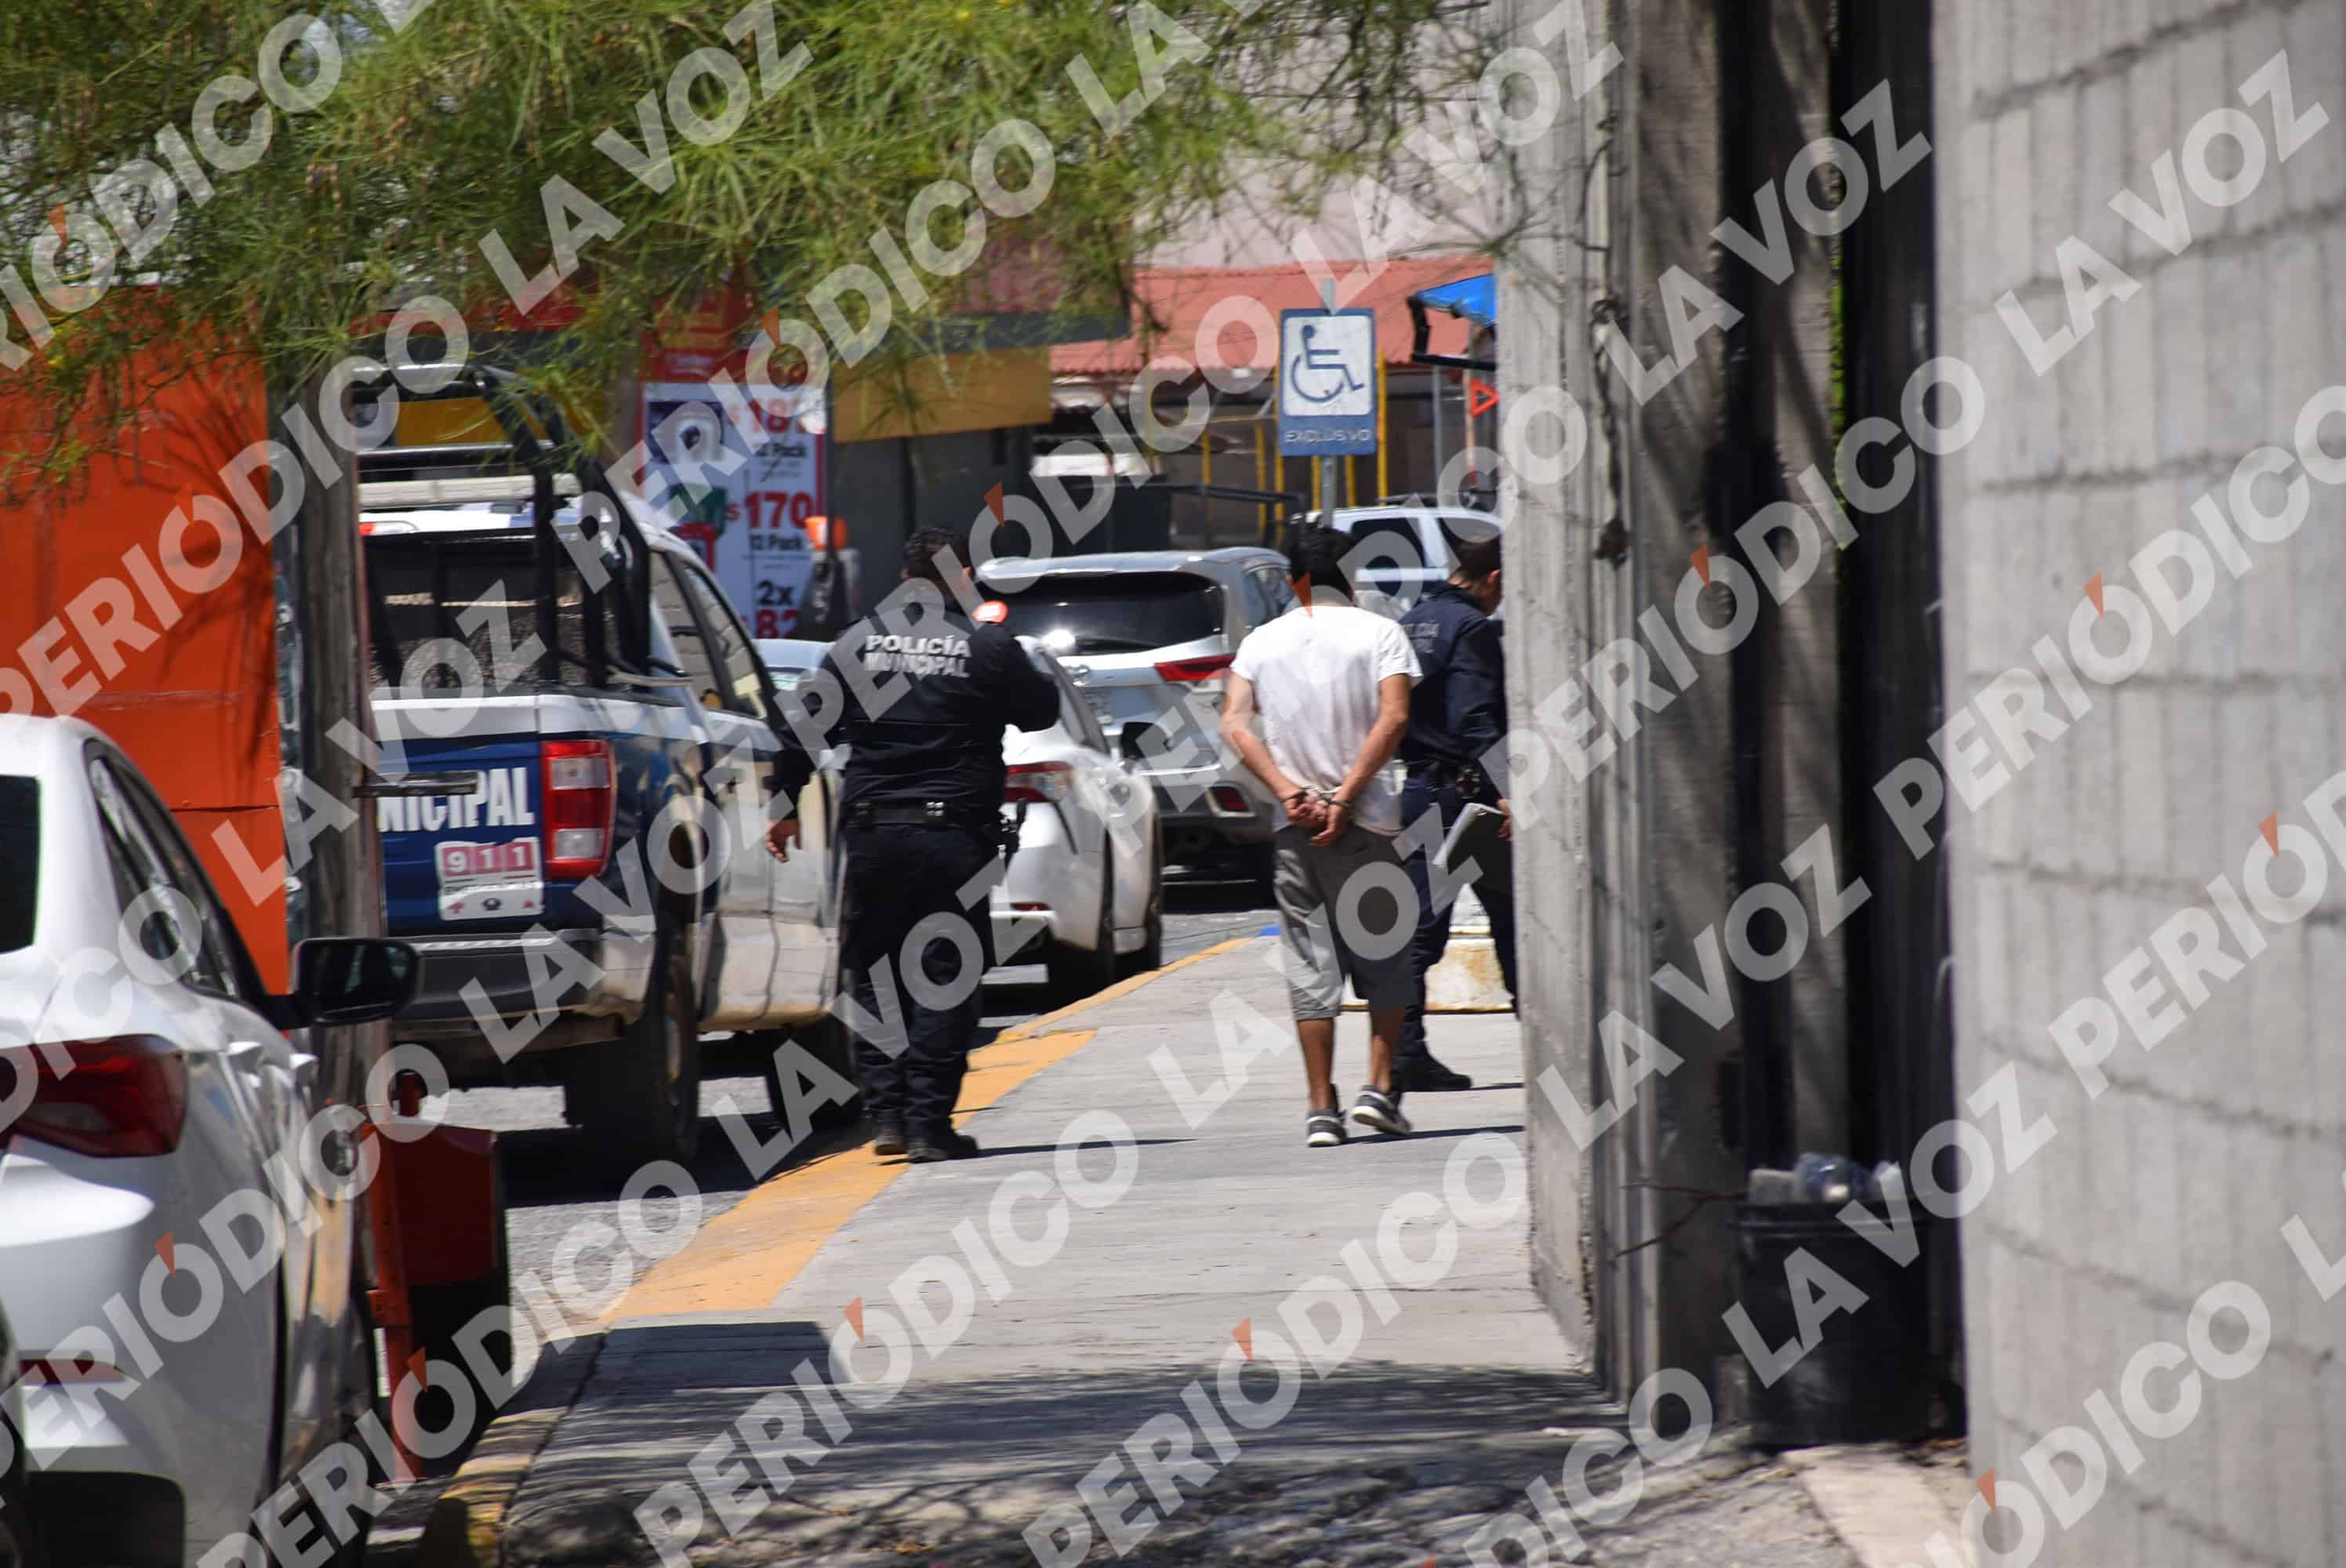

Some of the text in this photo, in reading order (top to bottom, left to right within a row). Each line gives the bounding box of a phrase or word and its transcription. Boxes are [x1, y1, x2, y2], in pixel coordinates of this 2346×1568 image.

[757, 580, 796, 606] 2x
[865, 634, 972, 658] POLICÍA
[377, 768, 535, 832] NICIPAL
[447, 846, 527, 873] 911
